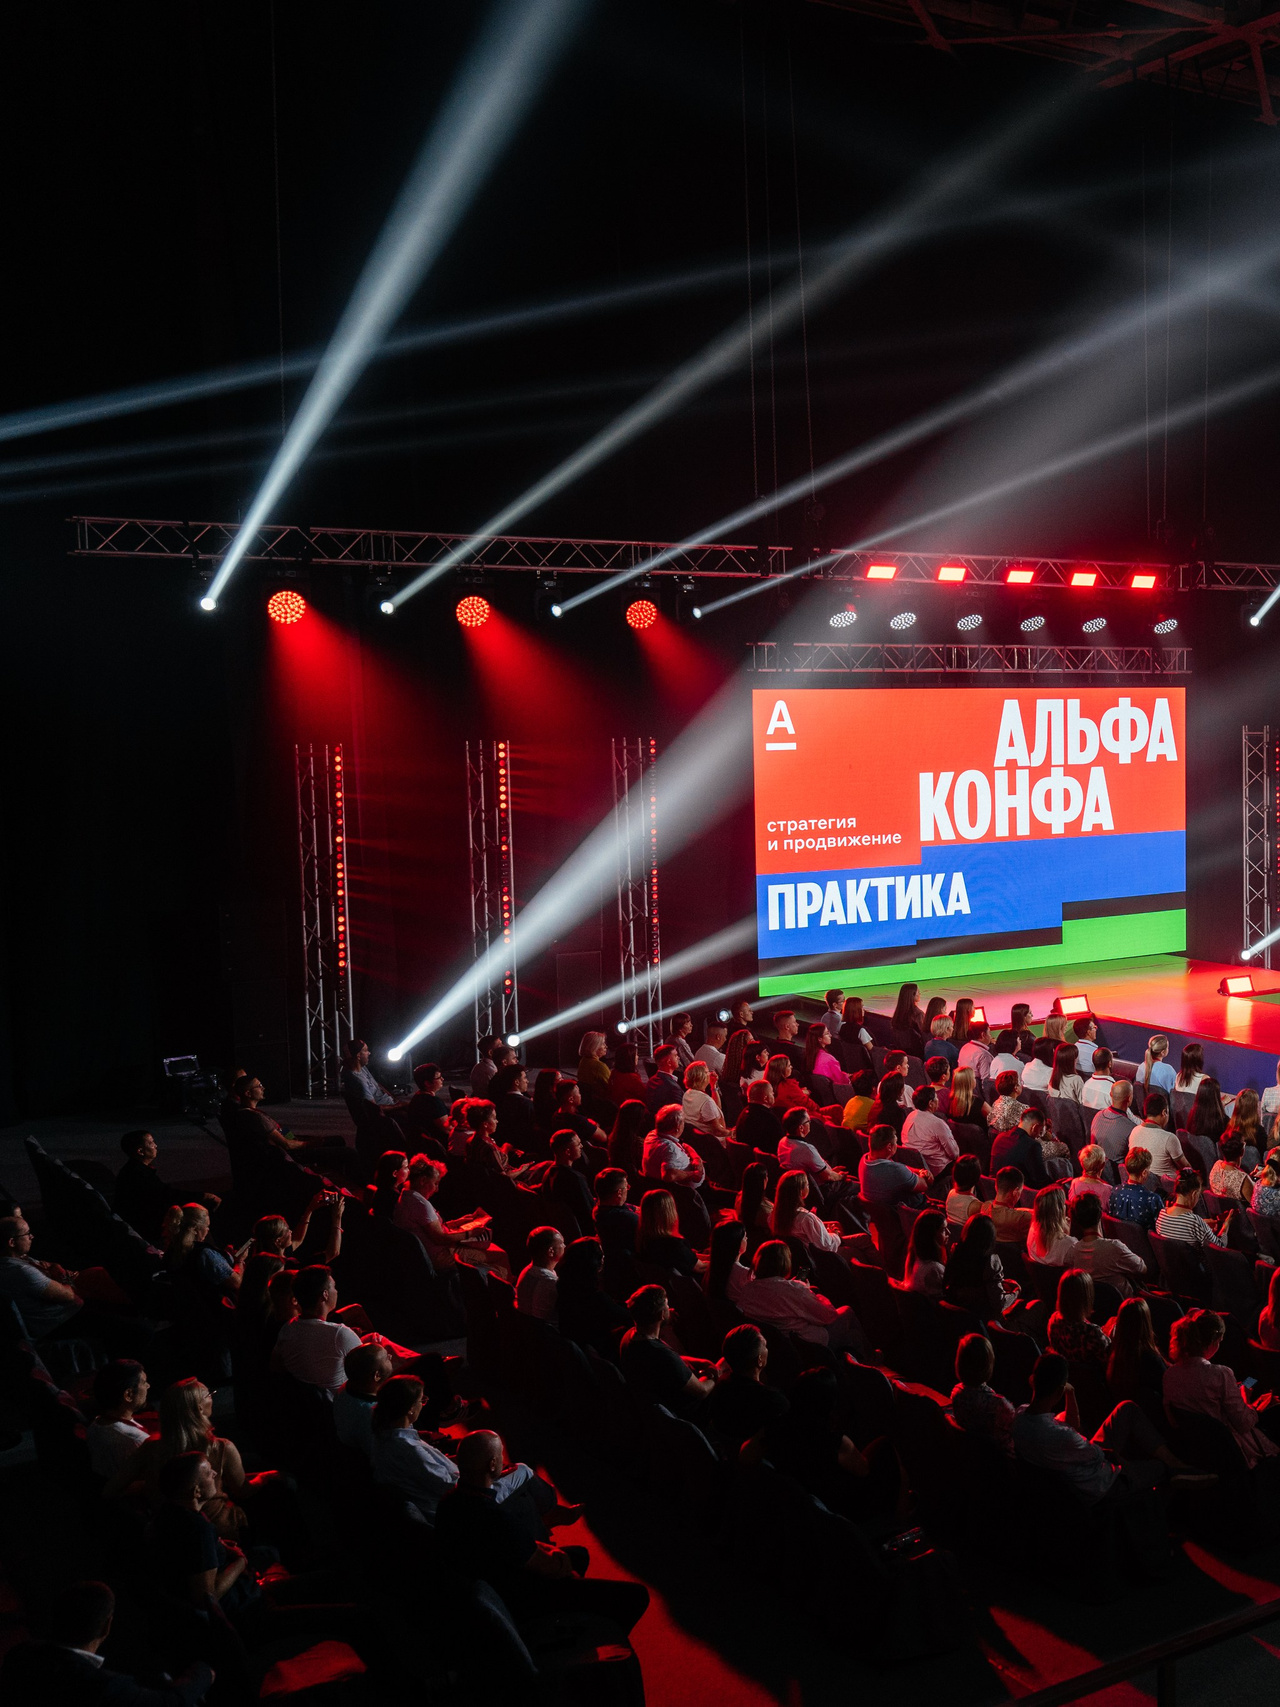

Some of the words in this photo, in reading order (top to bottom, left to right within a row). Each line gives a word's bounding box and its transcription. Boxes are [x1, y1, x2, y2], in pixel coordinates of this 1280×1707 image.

[766, 700, 796, 736] А
[993, 697, 1178, 768] АЛЬФА
[766, 817, 857, 836] стратегия
[918, 766, 1115, 842] КОНФА
[767, 839, 778, 851] и
[783, 833, 902, 854] продвижение
[767, 871, 972, 931] ПРАКТИКА
